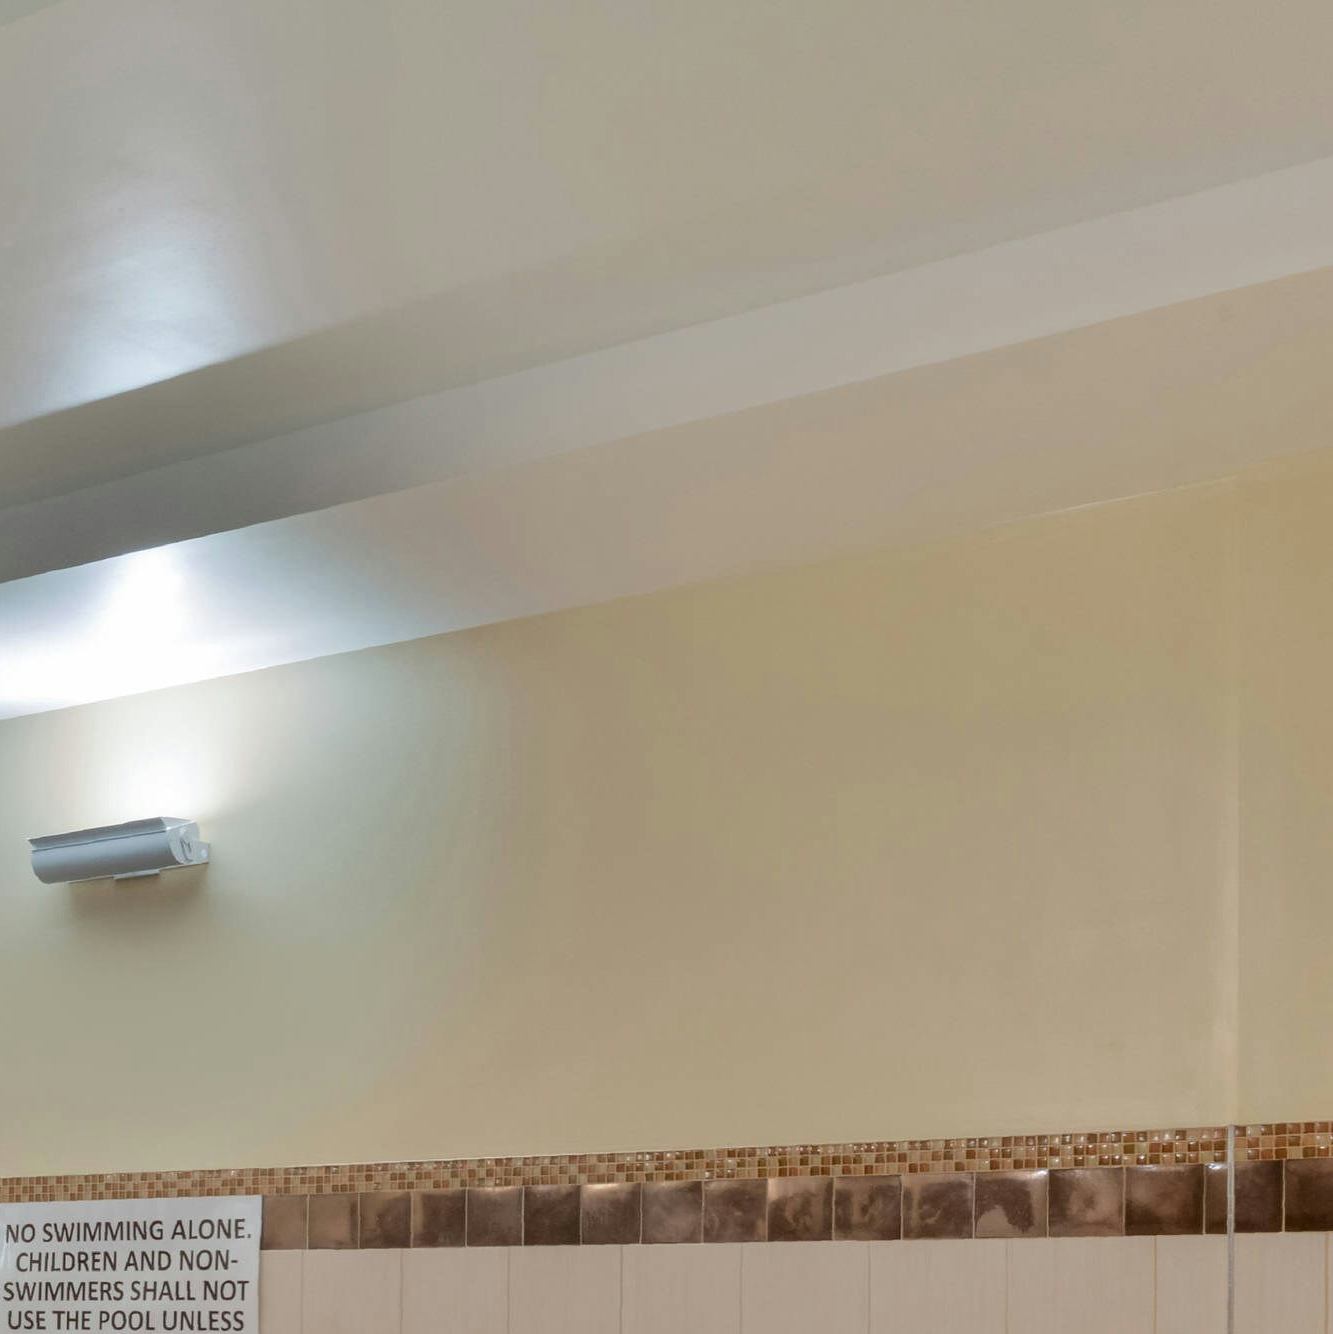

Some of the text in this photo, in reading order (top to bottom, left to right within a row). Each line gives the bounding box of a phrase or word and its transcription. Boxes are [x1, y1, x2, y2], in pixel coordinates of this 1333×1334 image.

[6, 1218, 252, 1243] NO SWIMMING ALONE.
[16, 1250, 238, 1272] CHILDREN AND NON-
[3, 1280, 249, 1301] SWIMMERS SHALL NOT
[7, 1310, 244, 1331] USE THE POOL UNLESS
